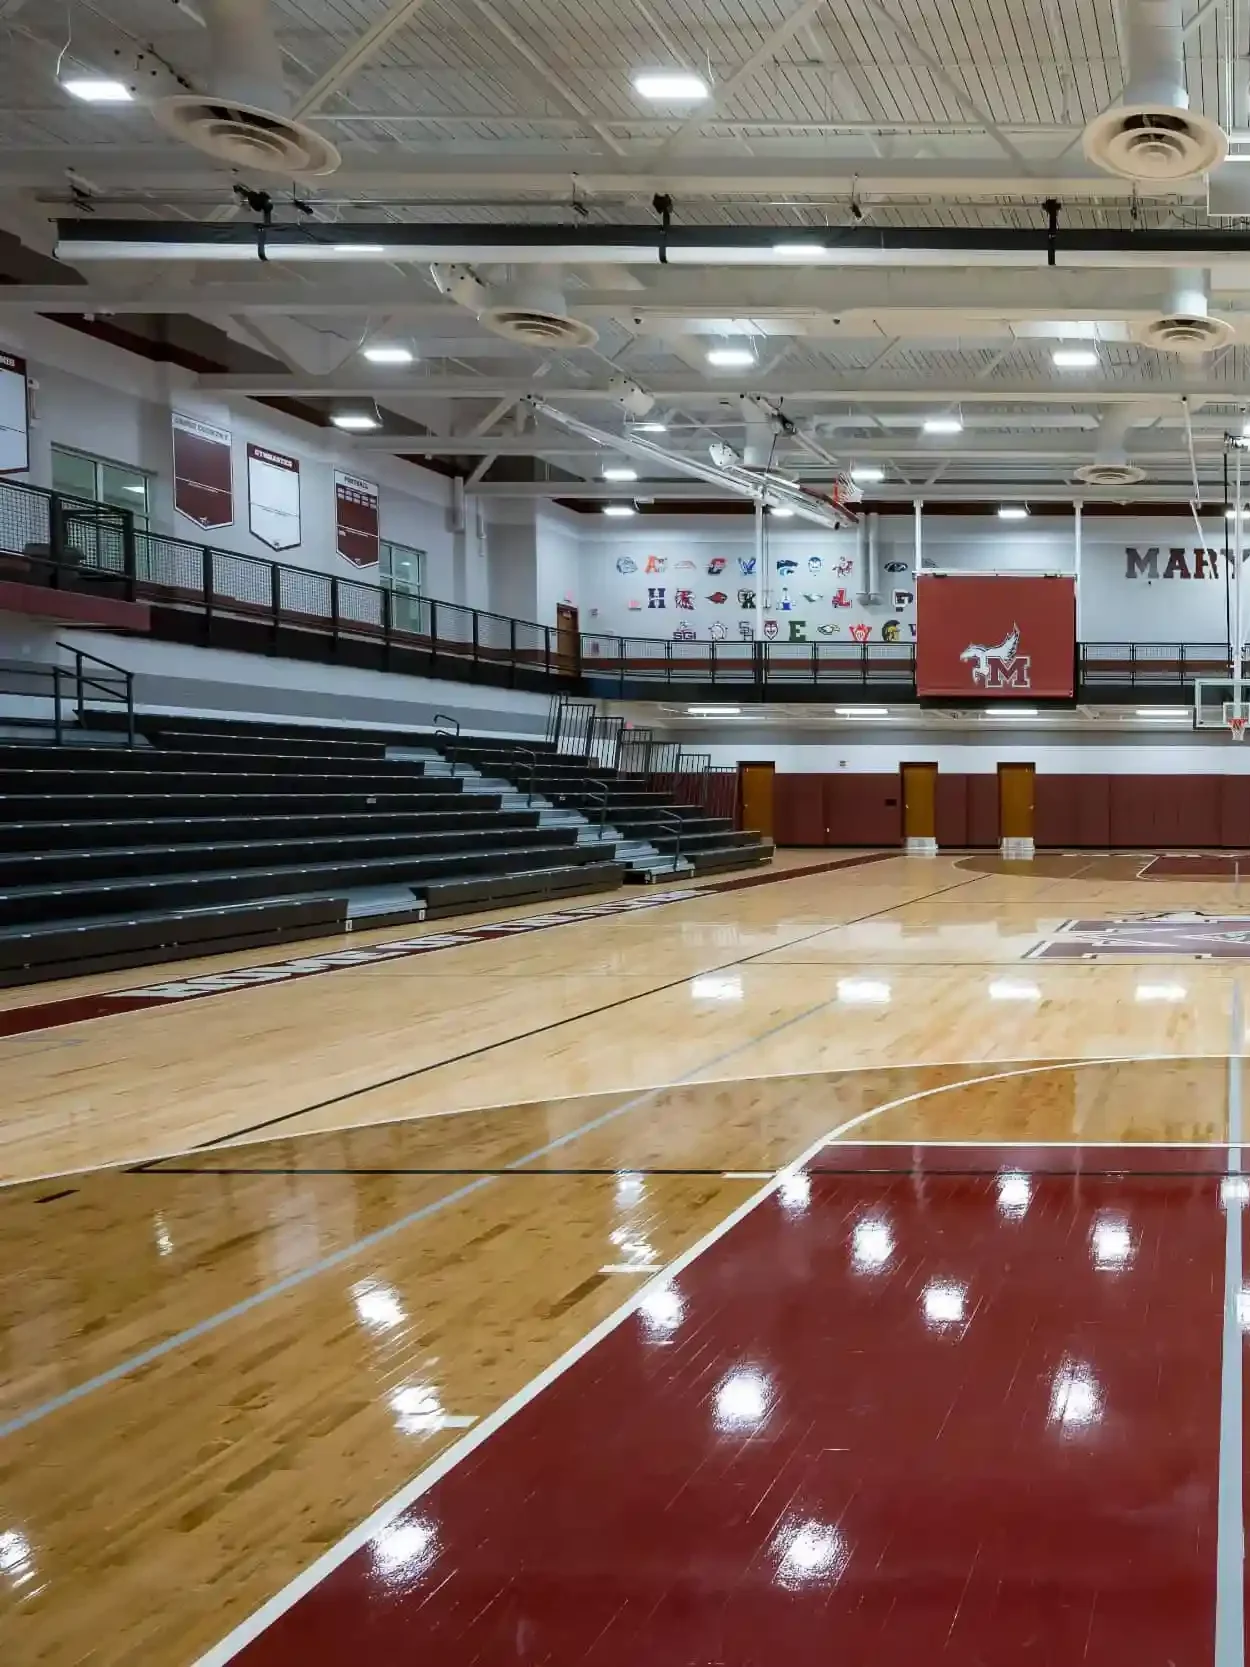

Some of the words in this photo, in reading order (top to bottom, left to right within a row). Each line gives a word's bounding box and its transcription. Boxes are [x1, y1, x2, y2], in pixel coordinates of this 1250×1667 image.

[648, 588, 666, 609] H
[673, 631, 697, 640] SGI
[788, 620, 807, 641] E
[985, 655, 1031, 688] M
